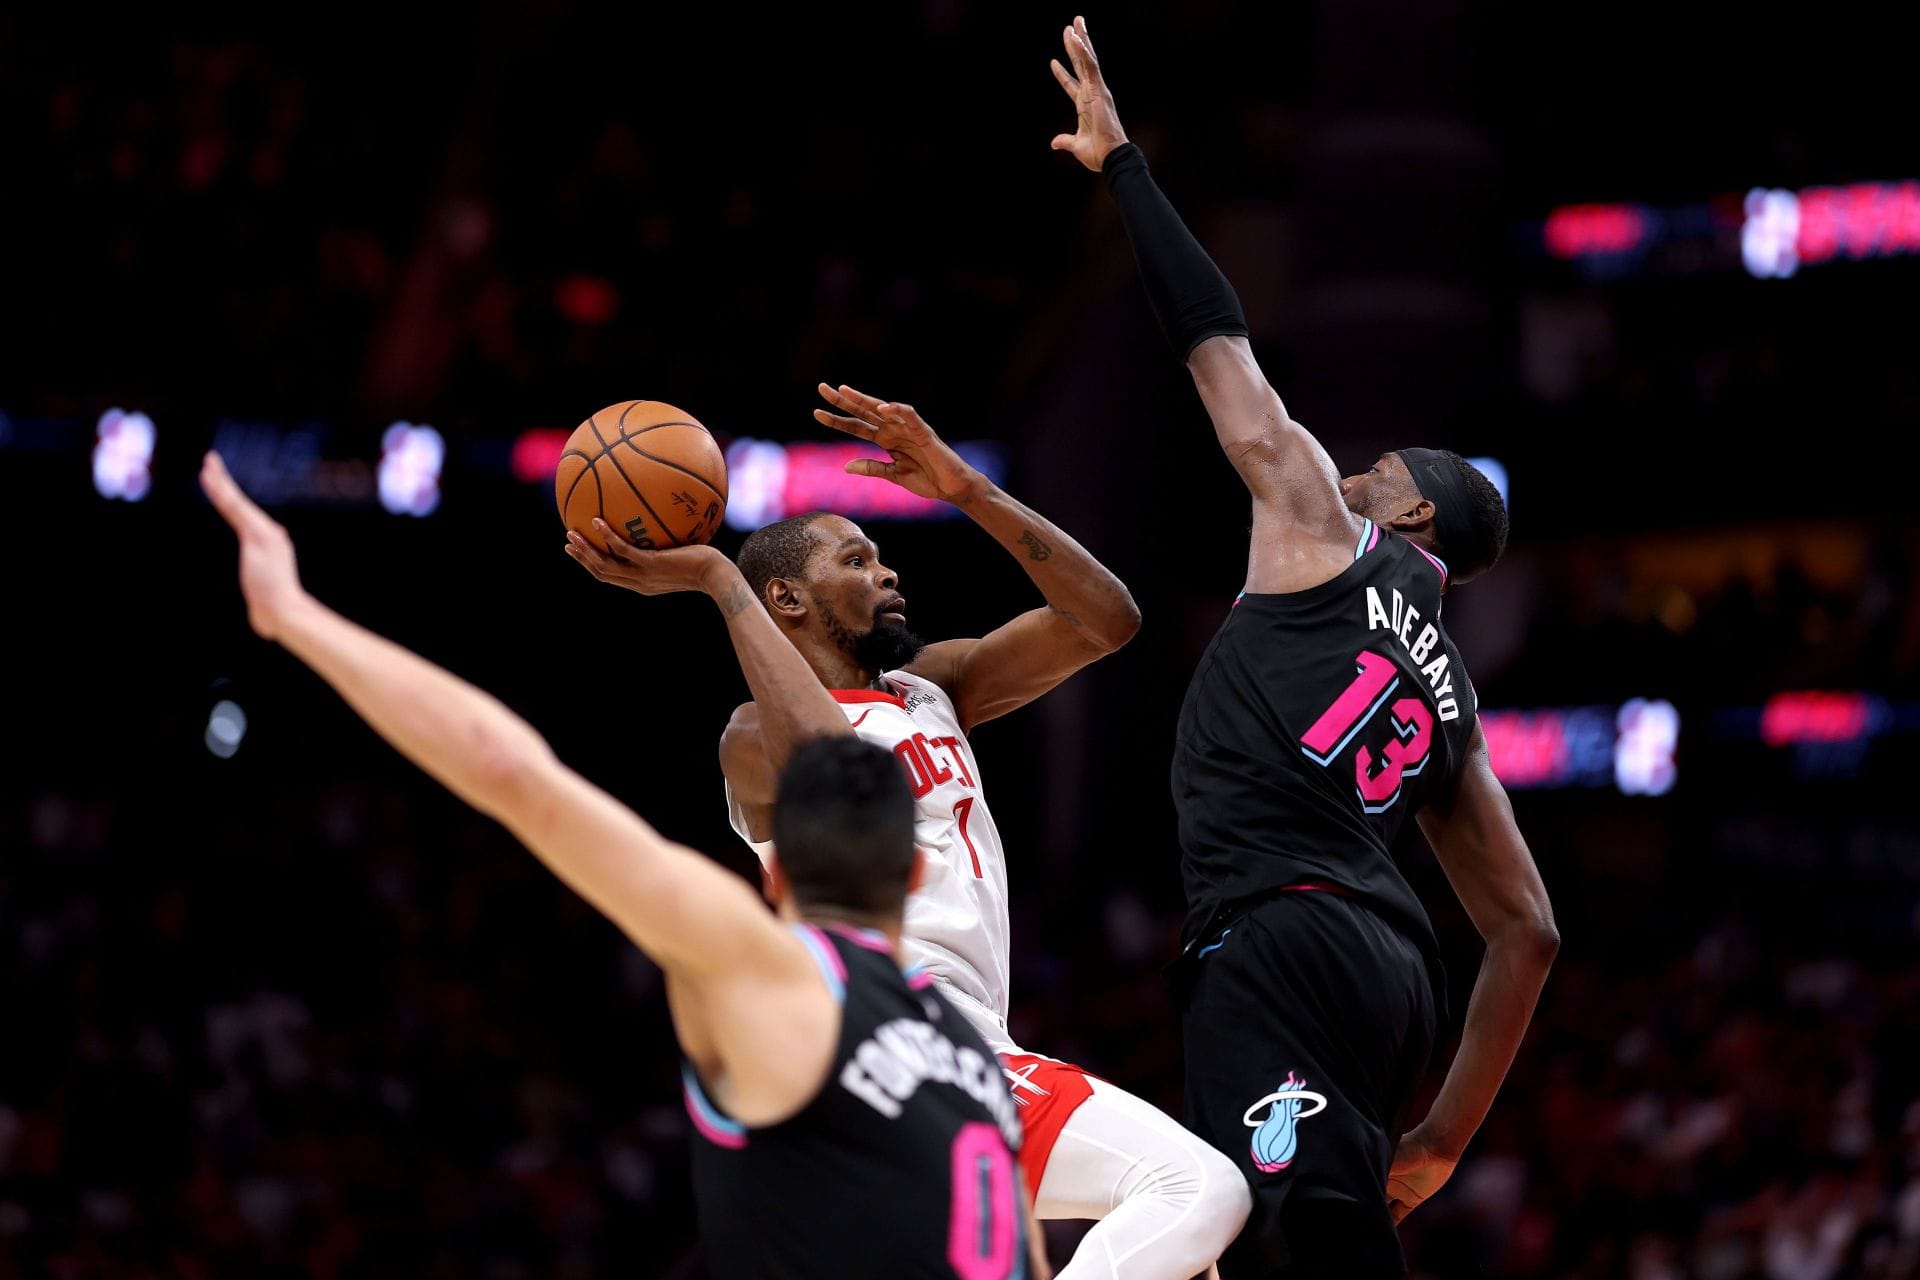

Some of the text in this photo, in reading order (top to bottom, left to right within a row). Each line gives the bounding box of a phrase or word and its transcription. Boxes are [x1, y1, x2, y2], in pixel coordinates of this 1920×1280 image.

[1299, 650, 1434, 814] 13
[1366, 586, 1459, 722] ADEBAYO
[947, 1120, 1022, 1280] 0
